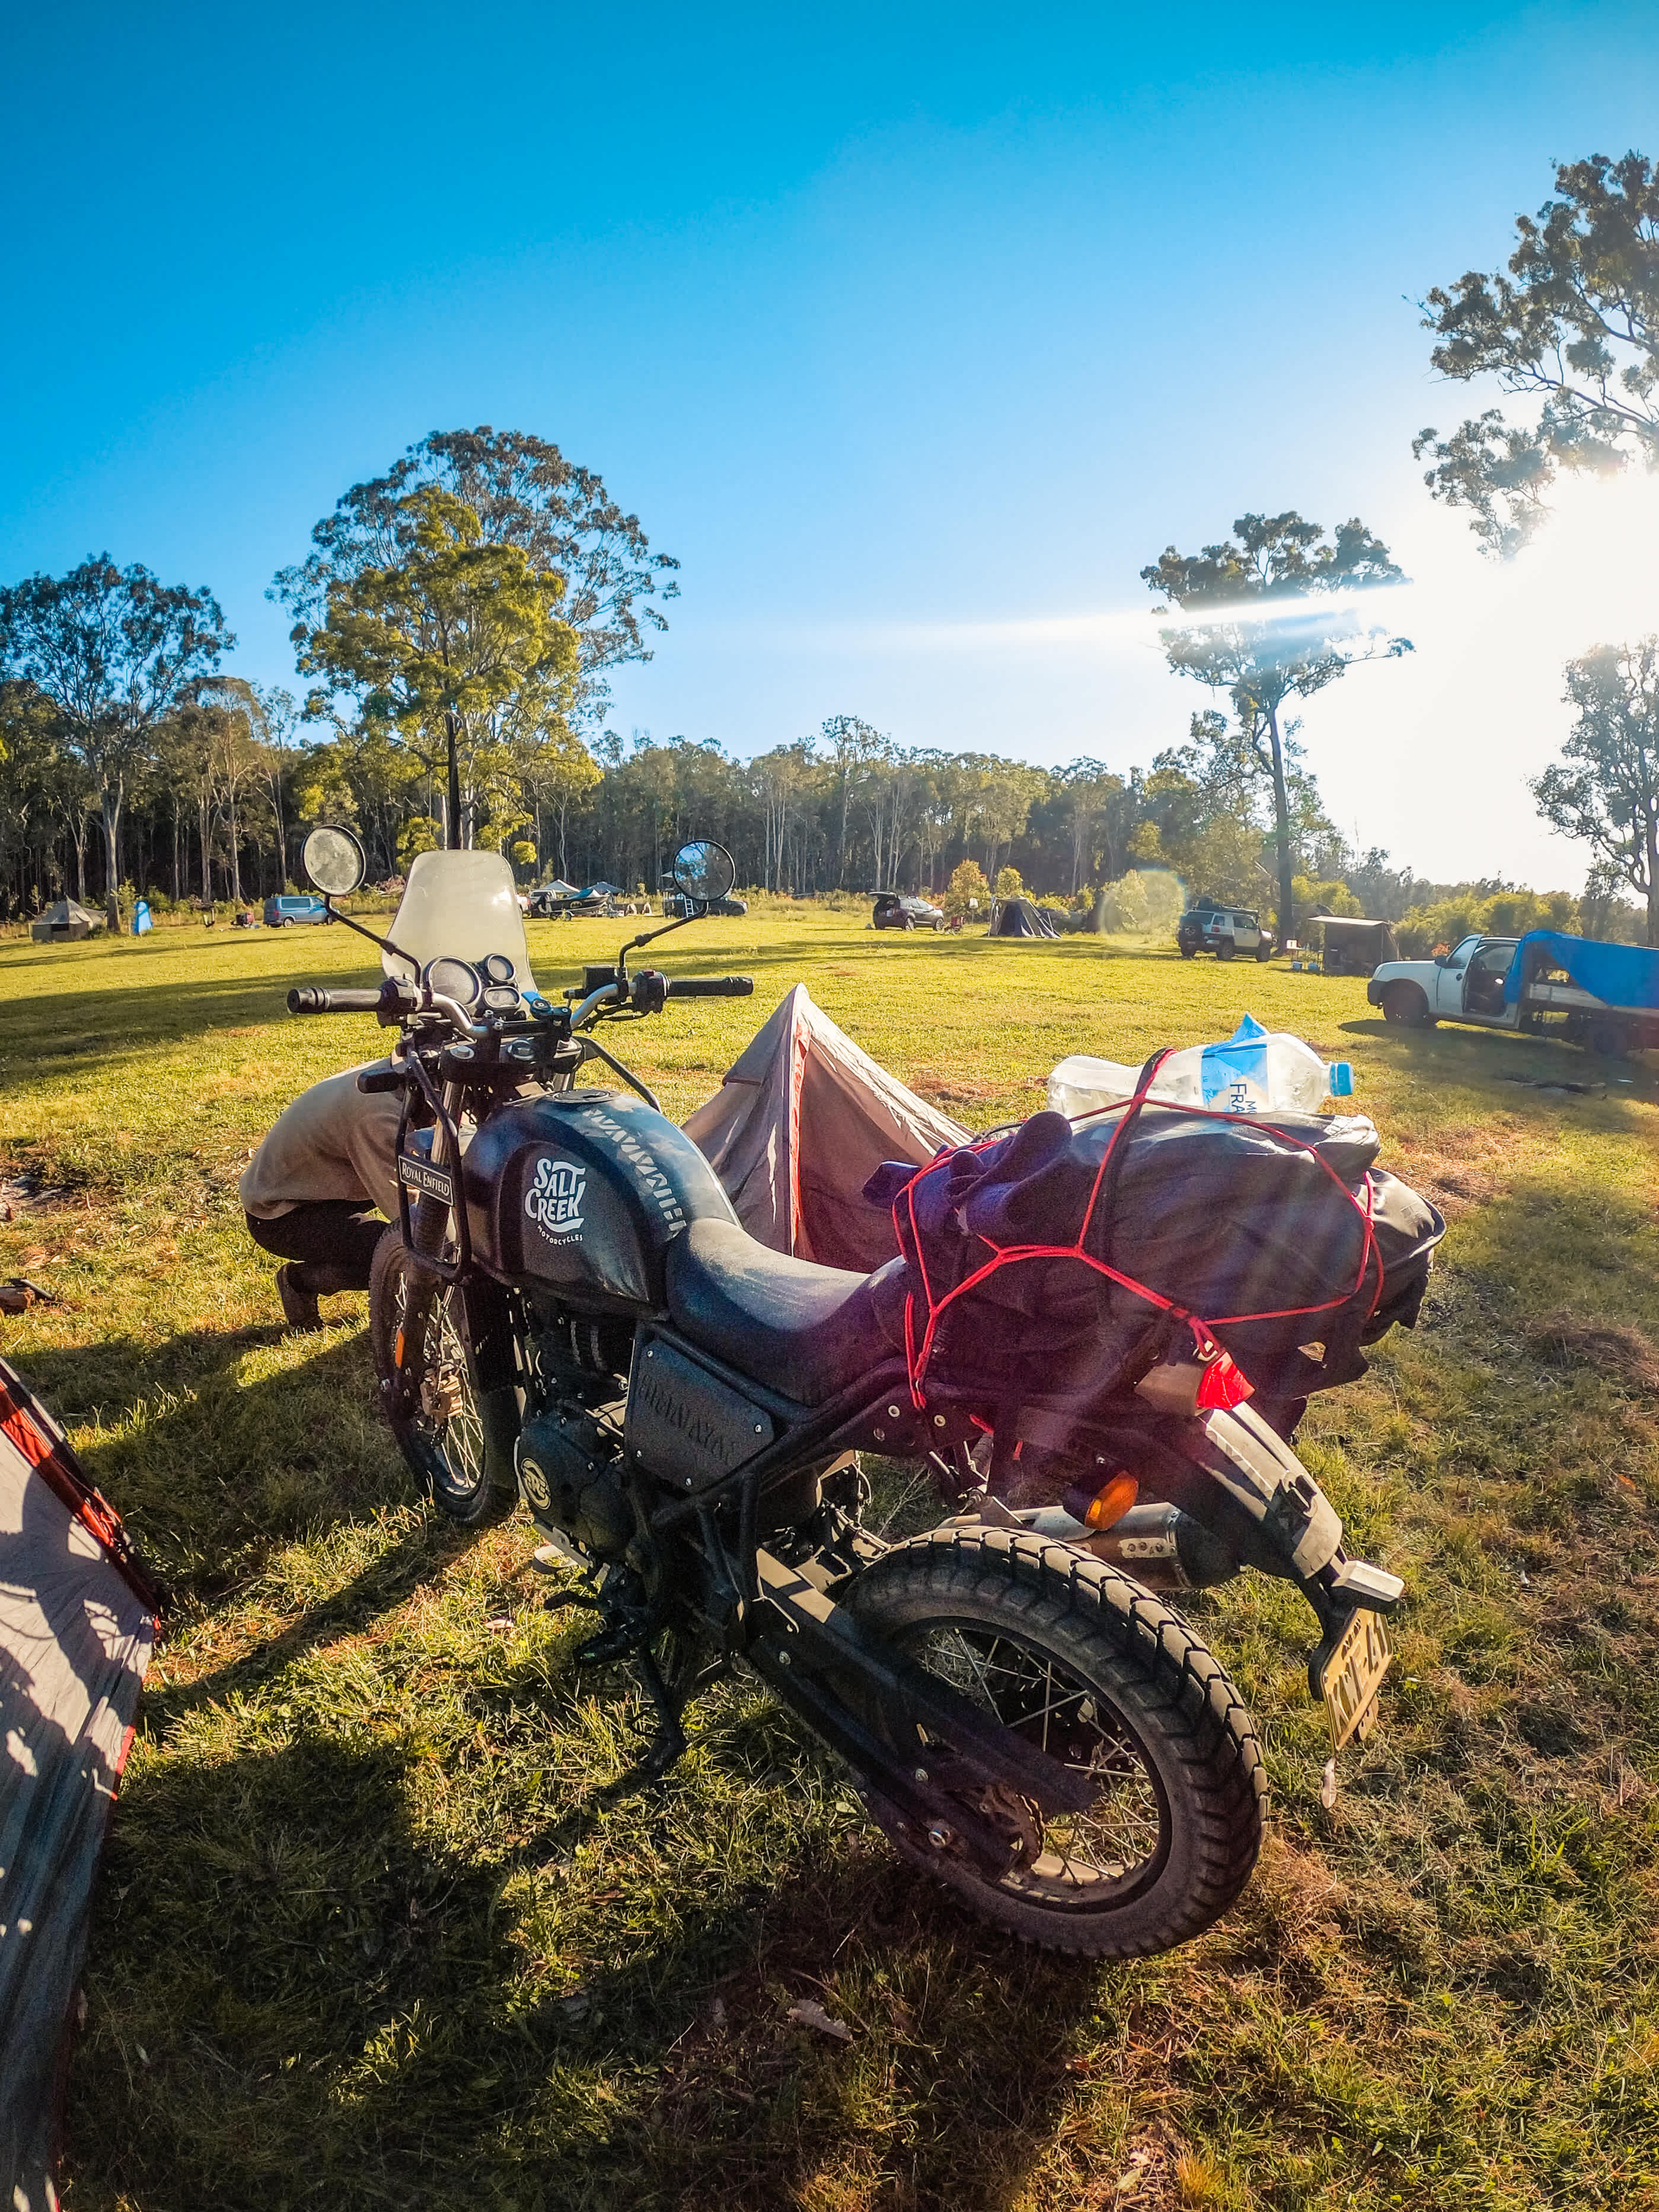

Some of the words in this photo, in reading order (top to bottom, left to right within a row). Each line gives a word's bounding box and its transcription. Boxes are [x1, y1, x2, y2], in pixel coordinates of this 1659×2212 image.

[401, 1161, 422, 1184] ROYAL
[423, 1171, 450, 1197] ENFIELD
[534, 1158, 586, 1197] SALT
[525, 1181, 586, 1233] CREEK
[537, 1224, 583, 1245] MOTORCYCLES
